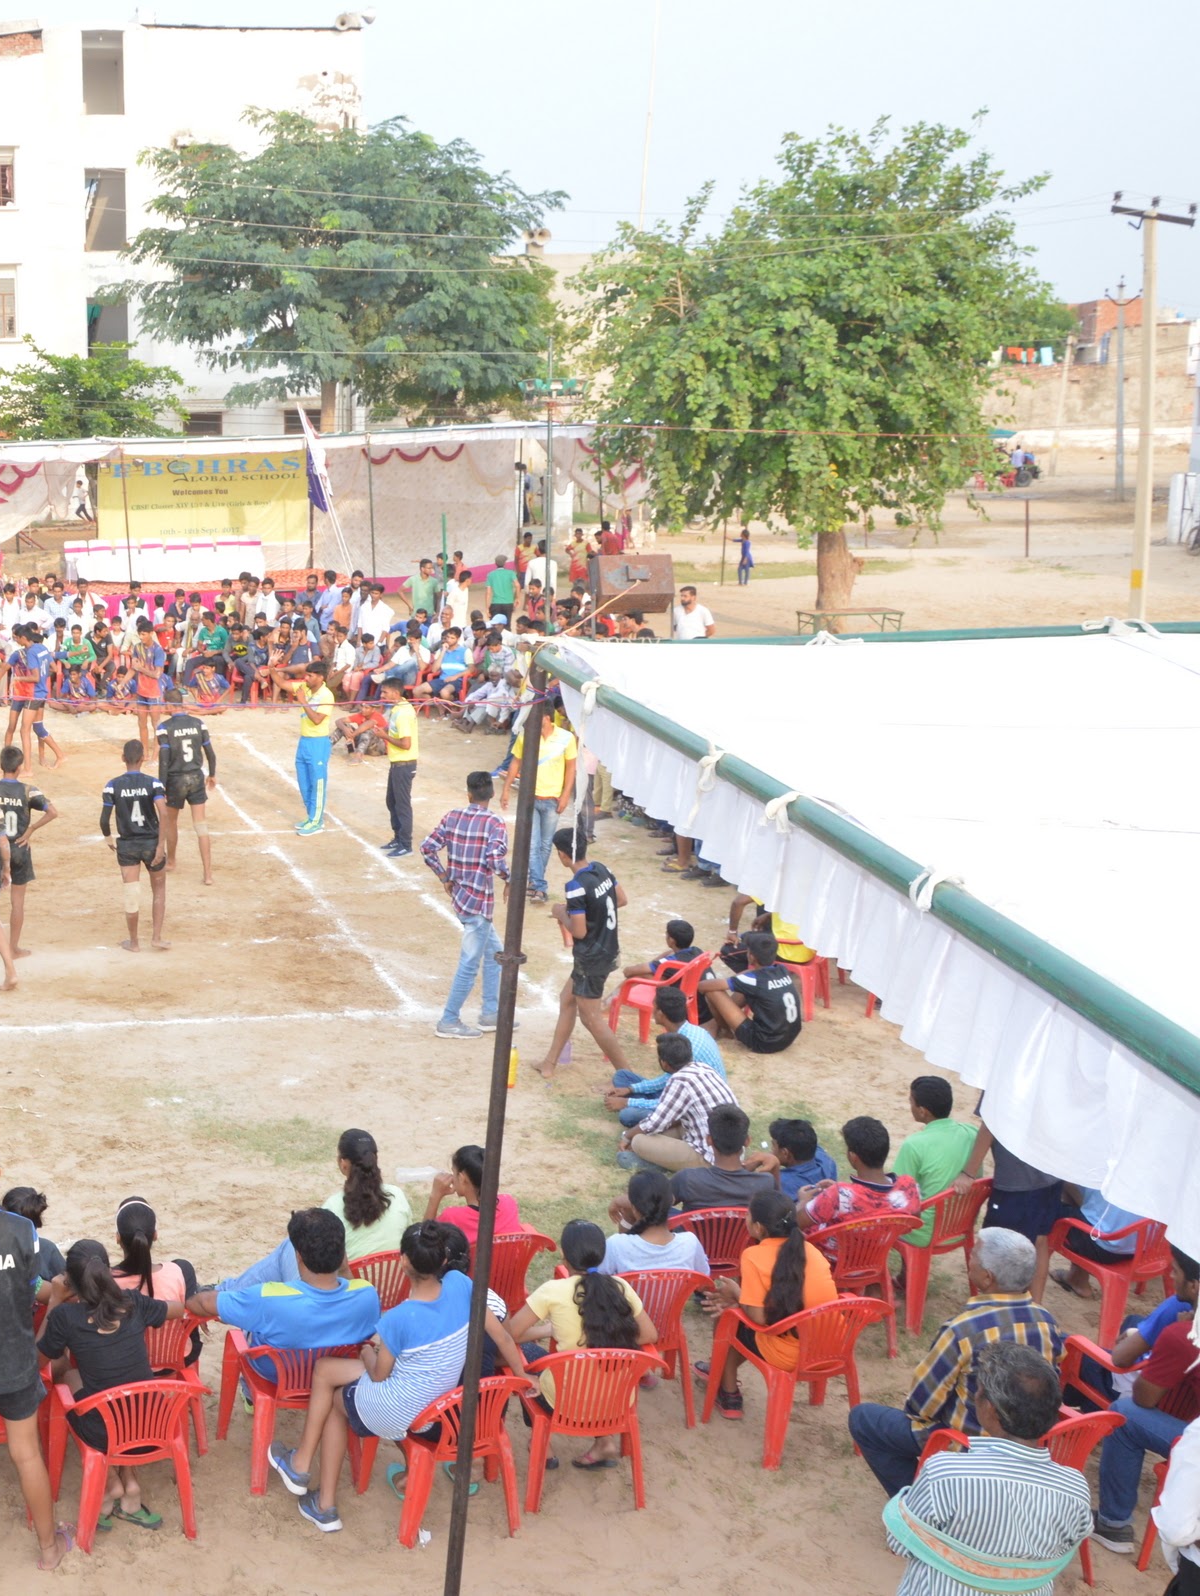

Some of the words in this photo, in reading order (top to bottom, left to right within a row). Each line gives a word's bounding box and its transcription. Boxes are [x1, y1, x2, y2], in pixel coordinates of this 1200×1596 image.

[241, 472, 300, 481] SCHOOL
[172, 488, 213, 497] Welcomes
[215, 488, 228, 496] You
[174, 727, 198, 737] ALPHA
[181, 739, 194, 763] 5
[120, 787, 148, 798] ALPHA
[130, 800, 145, 827] 4
[782, 992, 798, 1023] 8
